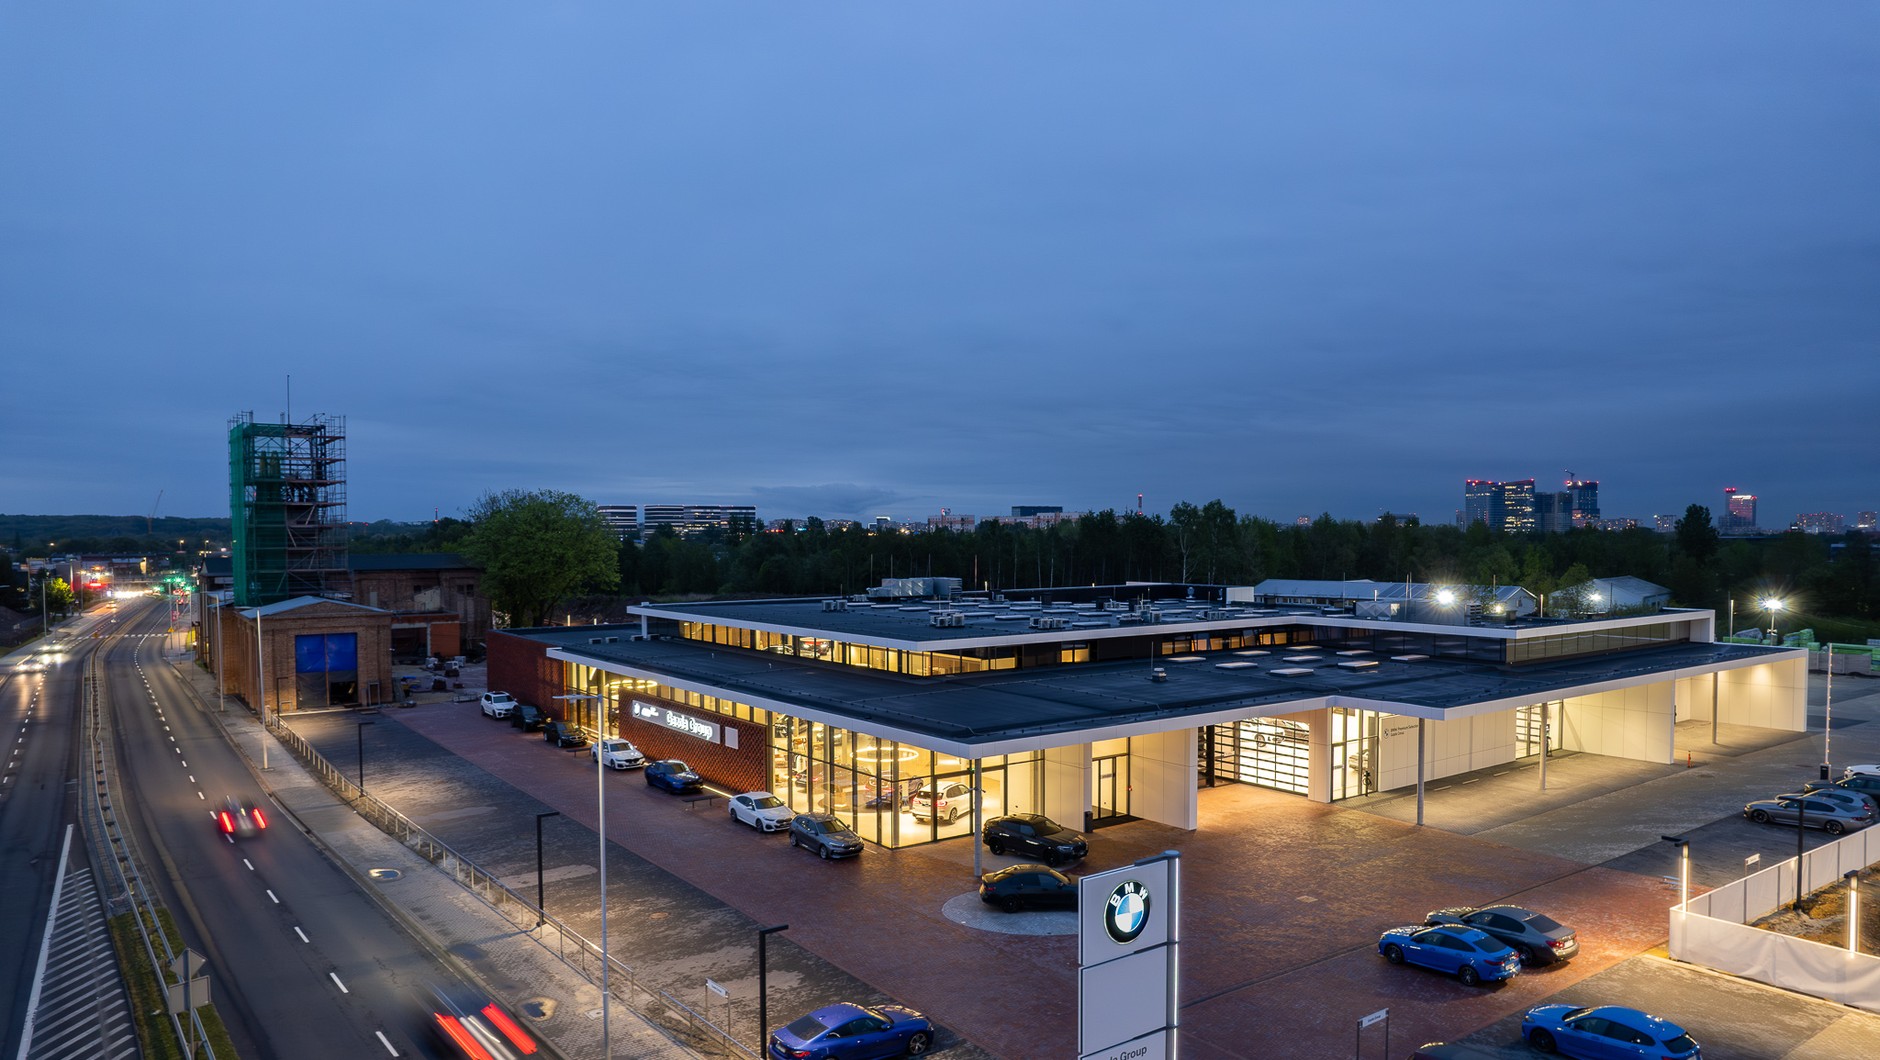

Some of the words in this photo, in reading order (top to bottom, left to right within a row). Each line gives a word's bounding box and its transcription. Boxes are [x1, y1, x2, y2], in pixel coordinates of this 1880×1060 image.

[690, 717, 713, 740] Group
[1110, 882, 1148, 907] BMW
[1120, 1046, 1147, 1060] Group
